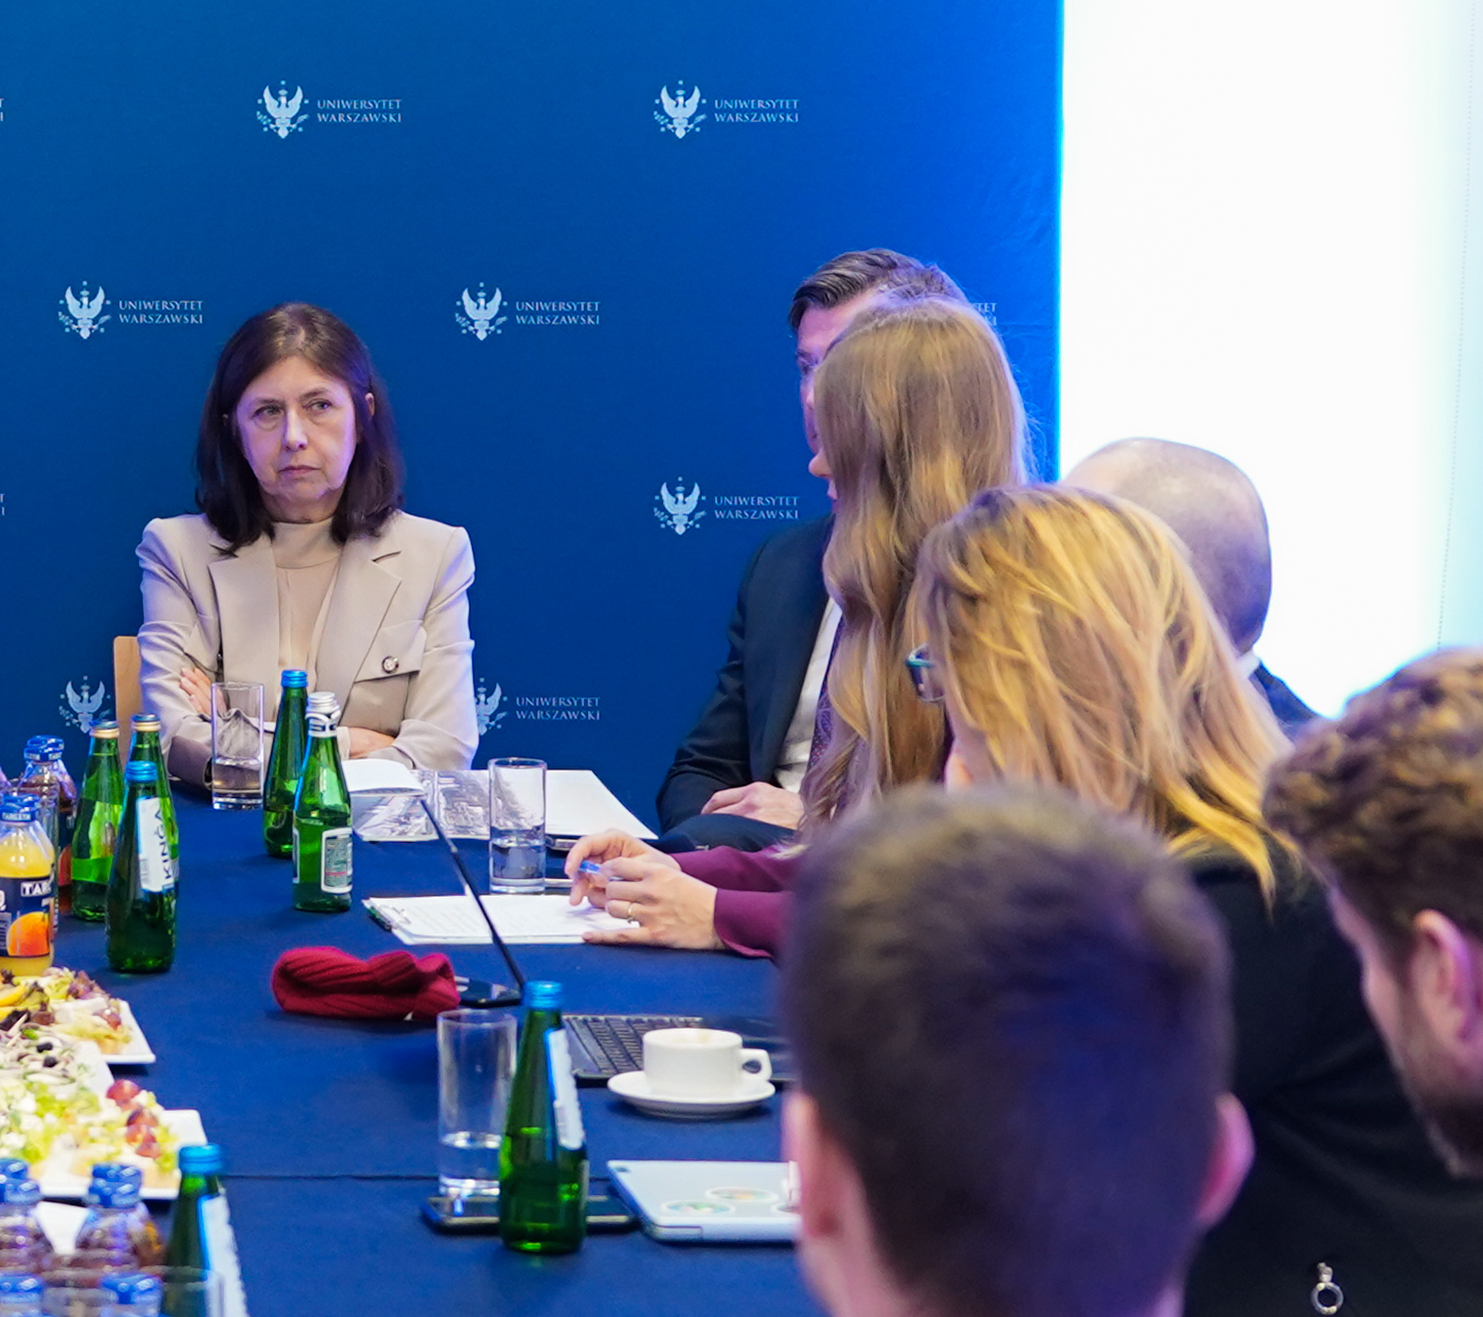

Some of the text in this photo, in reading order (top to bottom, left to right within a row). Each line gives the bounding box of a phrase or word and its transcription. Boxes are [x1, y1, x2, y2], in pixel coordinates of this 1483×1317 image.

[317, 98, 400, 110] UNIWERSYTET
[714, 99, 798, 109] UNIWERSYTET
[316, 112, 402, 123] WARSZAWSKI
[714, 112, 799, 123] WARSZAWSKI
[118, 300, 203, 311] UNIWERSYTET
[515, 301, 599, 312] UNIWERSYTET
[118, 313, 203, 324] WARSZAWSKI
[515, 314, 600, 325] WARSZAWSKI
[714, 496, 797, 506] UNIWERSYTET
[714, 509, 799, 520] WARSZAWSKI
[515, 696, 599, 707] UNIWERSYTET
[515, 710, 600, 721] WARSZAWSKI
